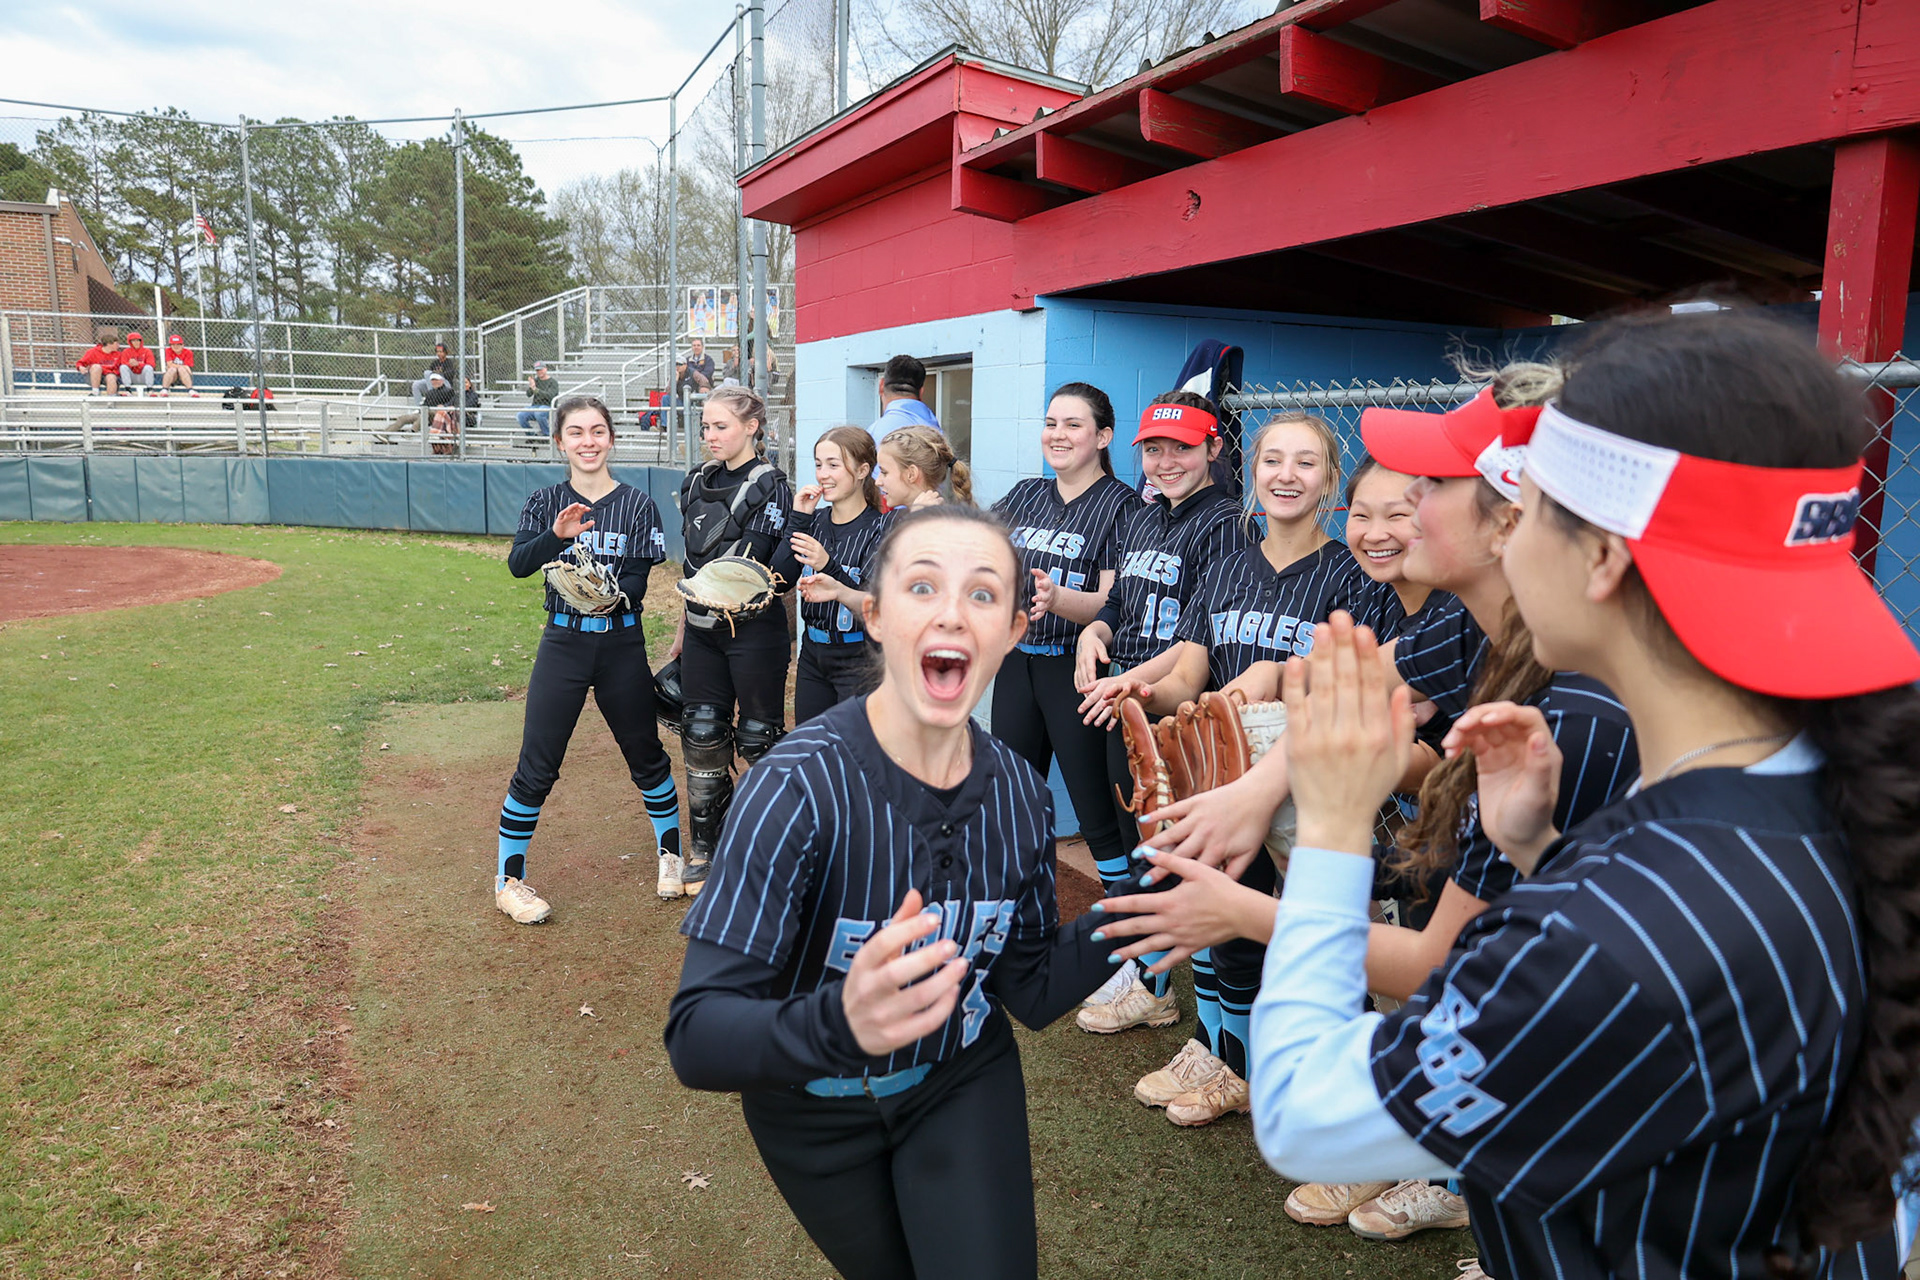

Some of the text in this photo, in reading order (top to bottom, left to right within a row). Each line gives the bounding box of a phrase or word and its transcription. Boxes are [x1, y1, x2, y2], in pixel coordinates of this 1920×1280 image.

[1152, 407, 1183, 420] SBA
[1119, 549, 1183, 587] EAGLES
[1139, 592, 1181, 640] 18
[1211, 610, 1318, 658] EAGLES
[1414, 982, 1508, 1138] SBA
